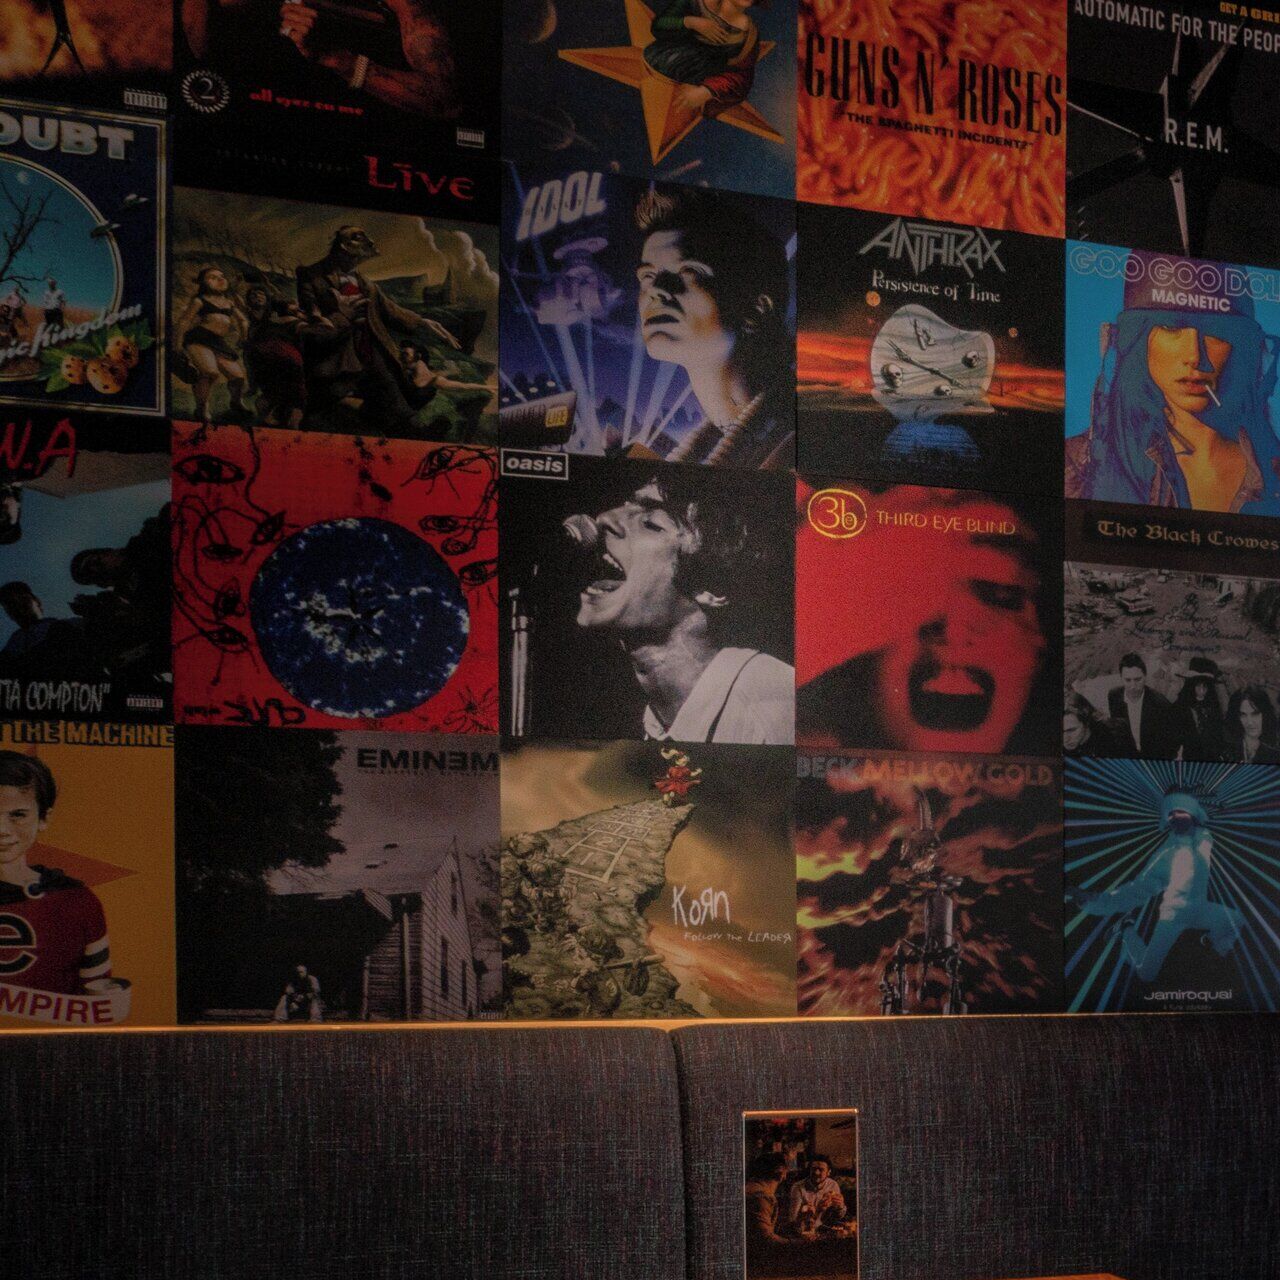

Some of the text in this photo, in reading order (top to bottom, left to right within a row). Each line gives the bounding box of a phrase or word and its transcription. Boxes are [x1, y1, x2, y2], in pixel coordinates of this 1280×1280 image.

[1074, 0, 1165, 31] AUTOMATIC
[1171, 13, 1203, 39] FOR
[1208, 20, 1237, 46] THE
[1219, 1, 1237, 15] GET
[1239, 5, 1248, 18] A
[804, 31, 899, 110] GUNS
[957, 57, 1062, 137] ROSES
[878, 116, 954, 138] SPAGHETTI
[1164, 117, 1230, 154] R.E.M.
[515, 169, 607, 242] IDOL
[858, 216, 1006, 279] ANTHRAX
[871, 268, 1001, 304] Persistence of Time
[1069, 246, 1145, 283] GOO
[1149, 257, 1222, 294] GOO
[1151, 287, 1231, 313] MAGNETIC
[29, 302, 143, 358] Kingdom
[506, 456, 564, 474] oasis
[876, 509, 928, 530] THIRD
[932, 514, 963, 534] EYE
[966, 517, 1016, 536] BLIND
[1096, 519, 1280, 551] The Black Crowes
[62, 721, 174, 747] MACHINE
[357, 748, 498, 771] EMINEM
[797, 755, 1054, 788] BECK MELLOW GOLD
[1143, 988, 1233, 1003] Jamiroquai
